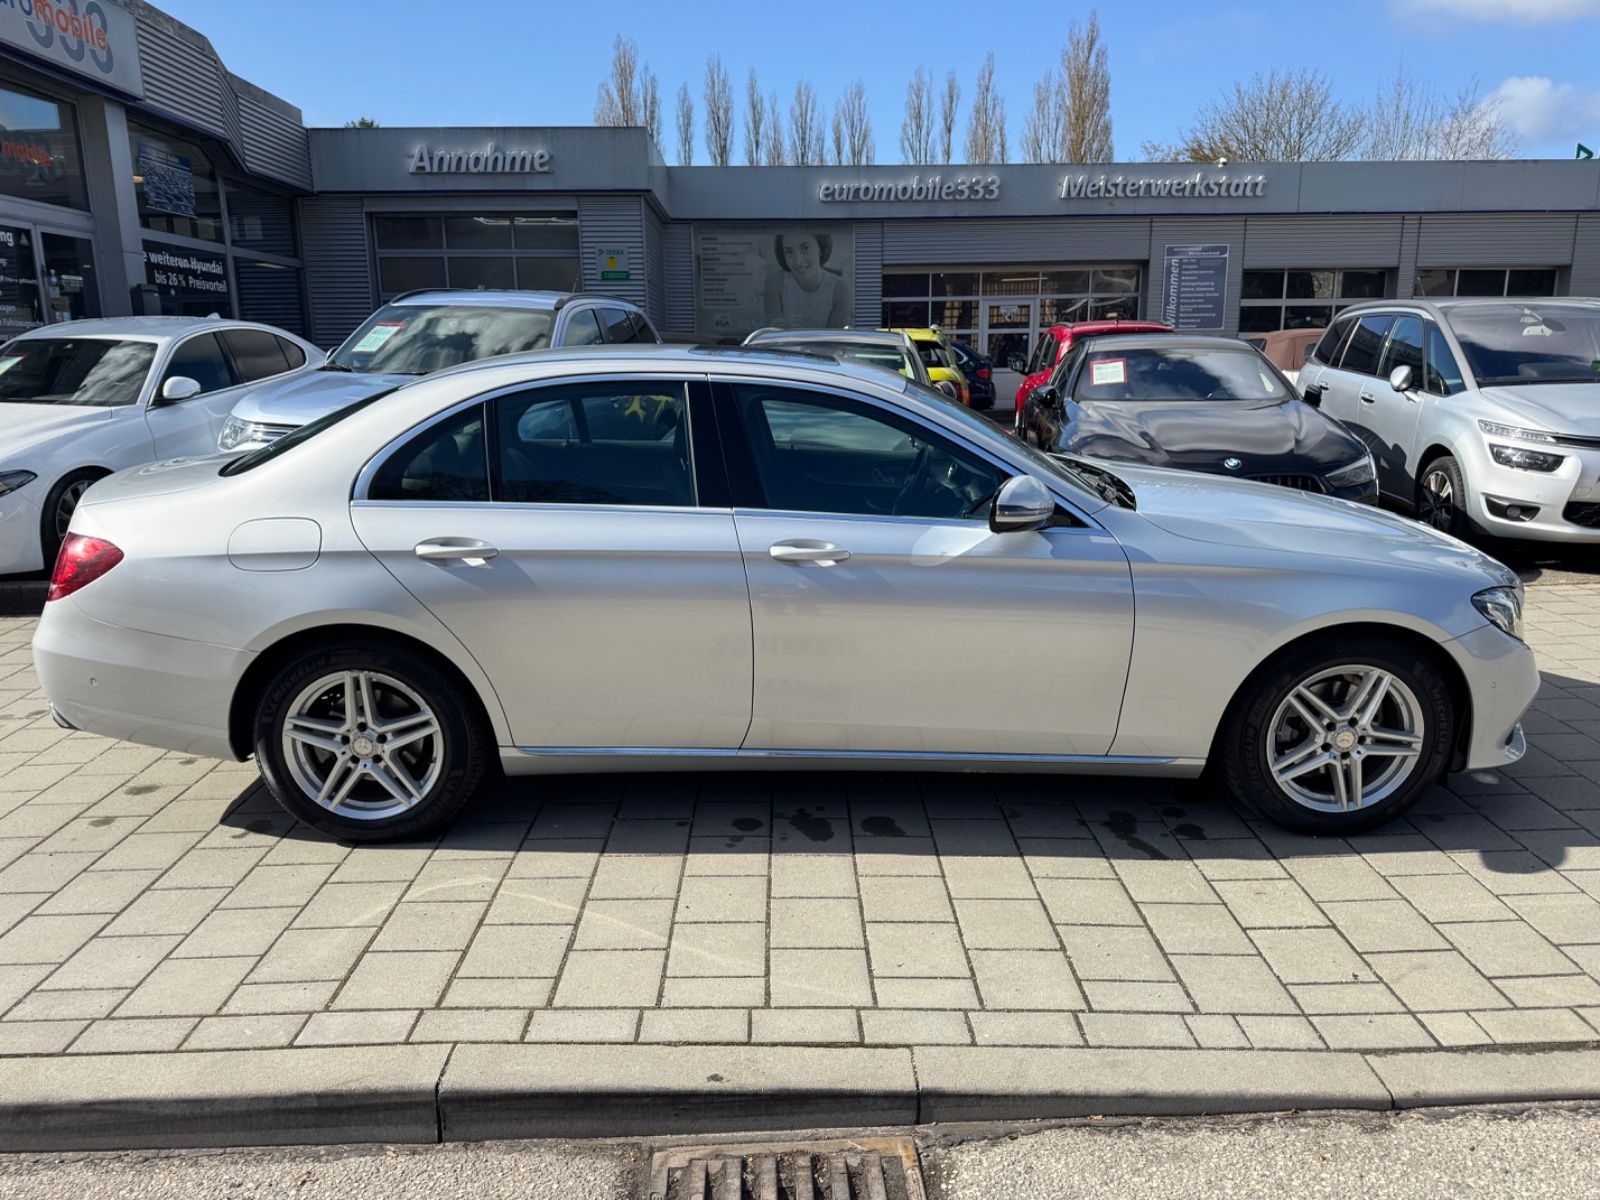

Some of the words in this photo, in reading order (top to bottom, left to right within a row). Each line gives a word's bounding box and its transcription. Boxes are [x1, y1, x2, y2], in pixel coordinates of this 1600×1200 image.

[409, 142, 550, 173] Annahme
[819, 176, 1000, 201] euromobile333
[1060, 172, 1267, 198] Meisterwerkstatt
[150, 252, 189, 267] weiteren
[191, 258, 223, 274] Hyundai
[155, 271, 166, 284] bis
[189, 277, 227, 292] Preisvorteil
